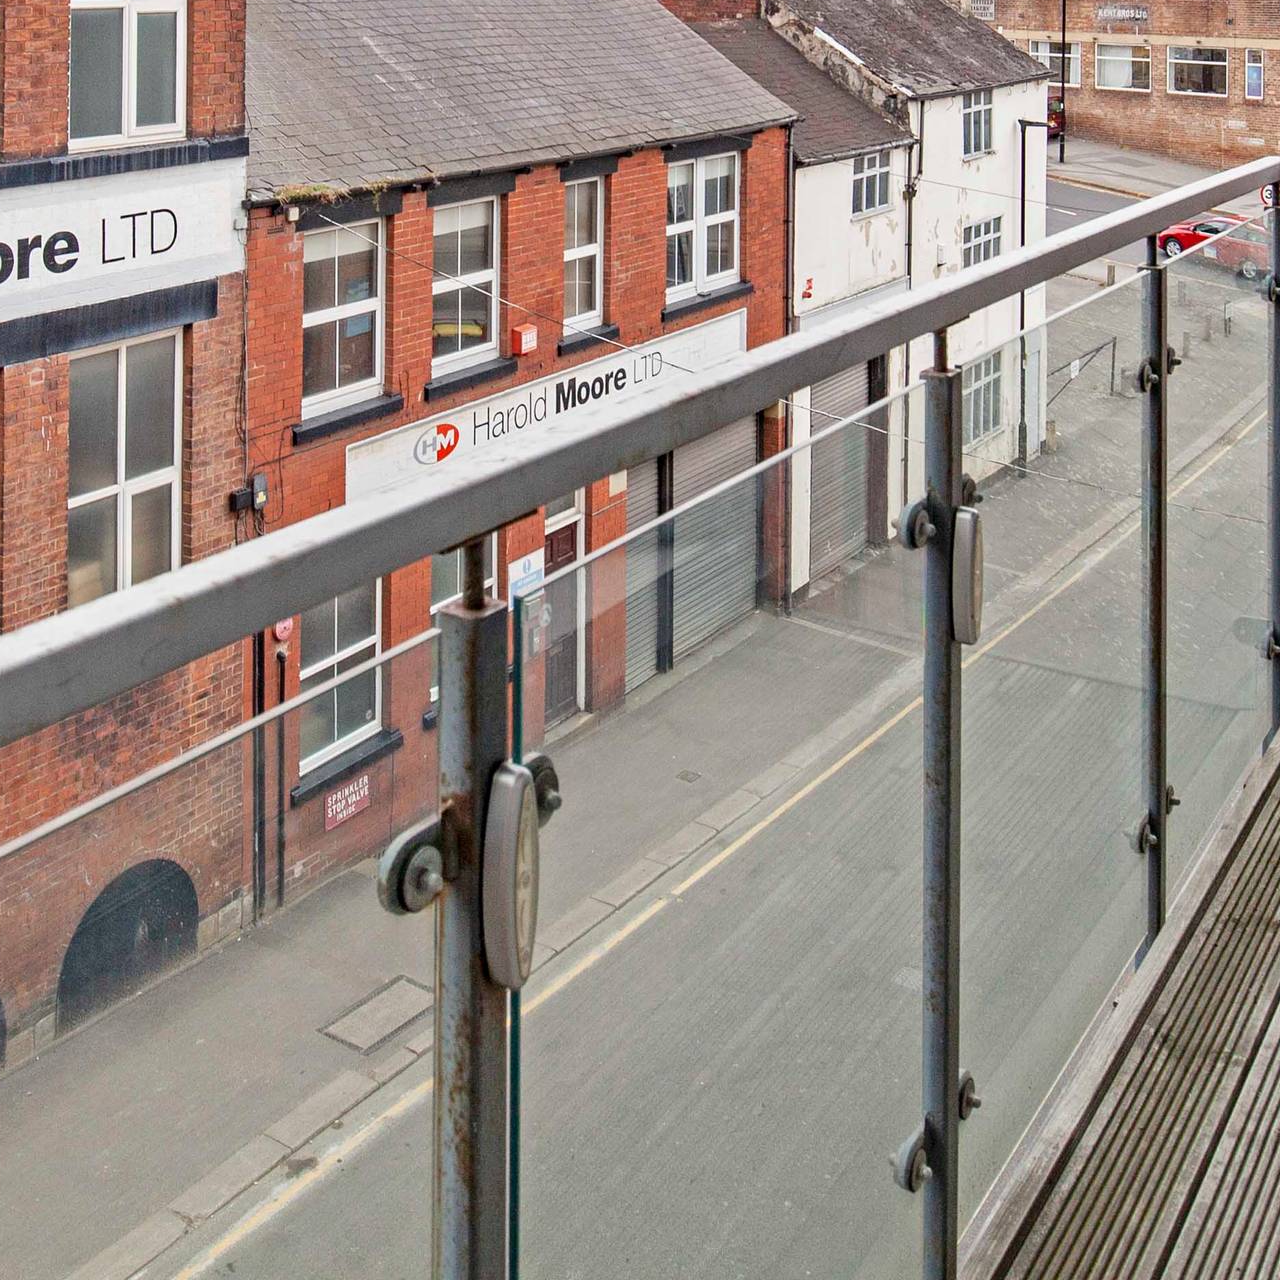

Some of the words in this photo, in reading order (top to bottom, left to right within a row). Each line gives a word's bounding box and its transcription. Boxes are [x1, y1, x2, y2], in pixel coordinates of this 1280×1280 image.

[102, 208, 178, 265] LTD
[473, 386, 548, 446] Harold
[555, 366, 627, 414] Moore
[634, 350, 664, 385] LTD
[421, 427, 456, 456] HM
[327, 775, 369, 808] SPRINKLER
[327, 799, 346, 818] STOP
[347, 785, 369, 806] VALVE
